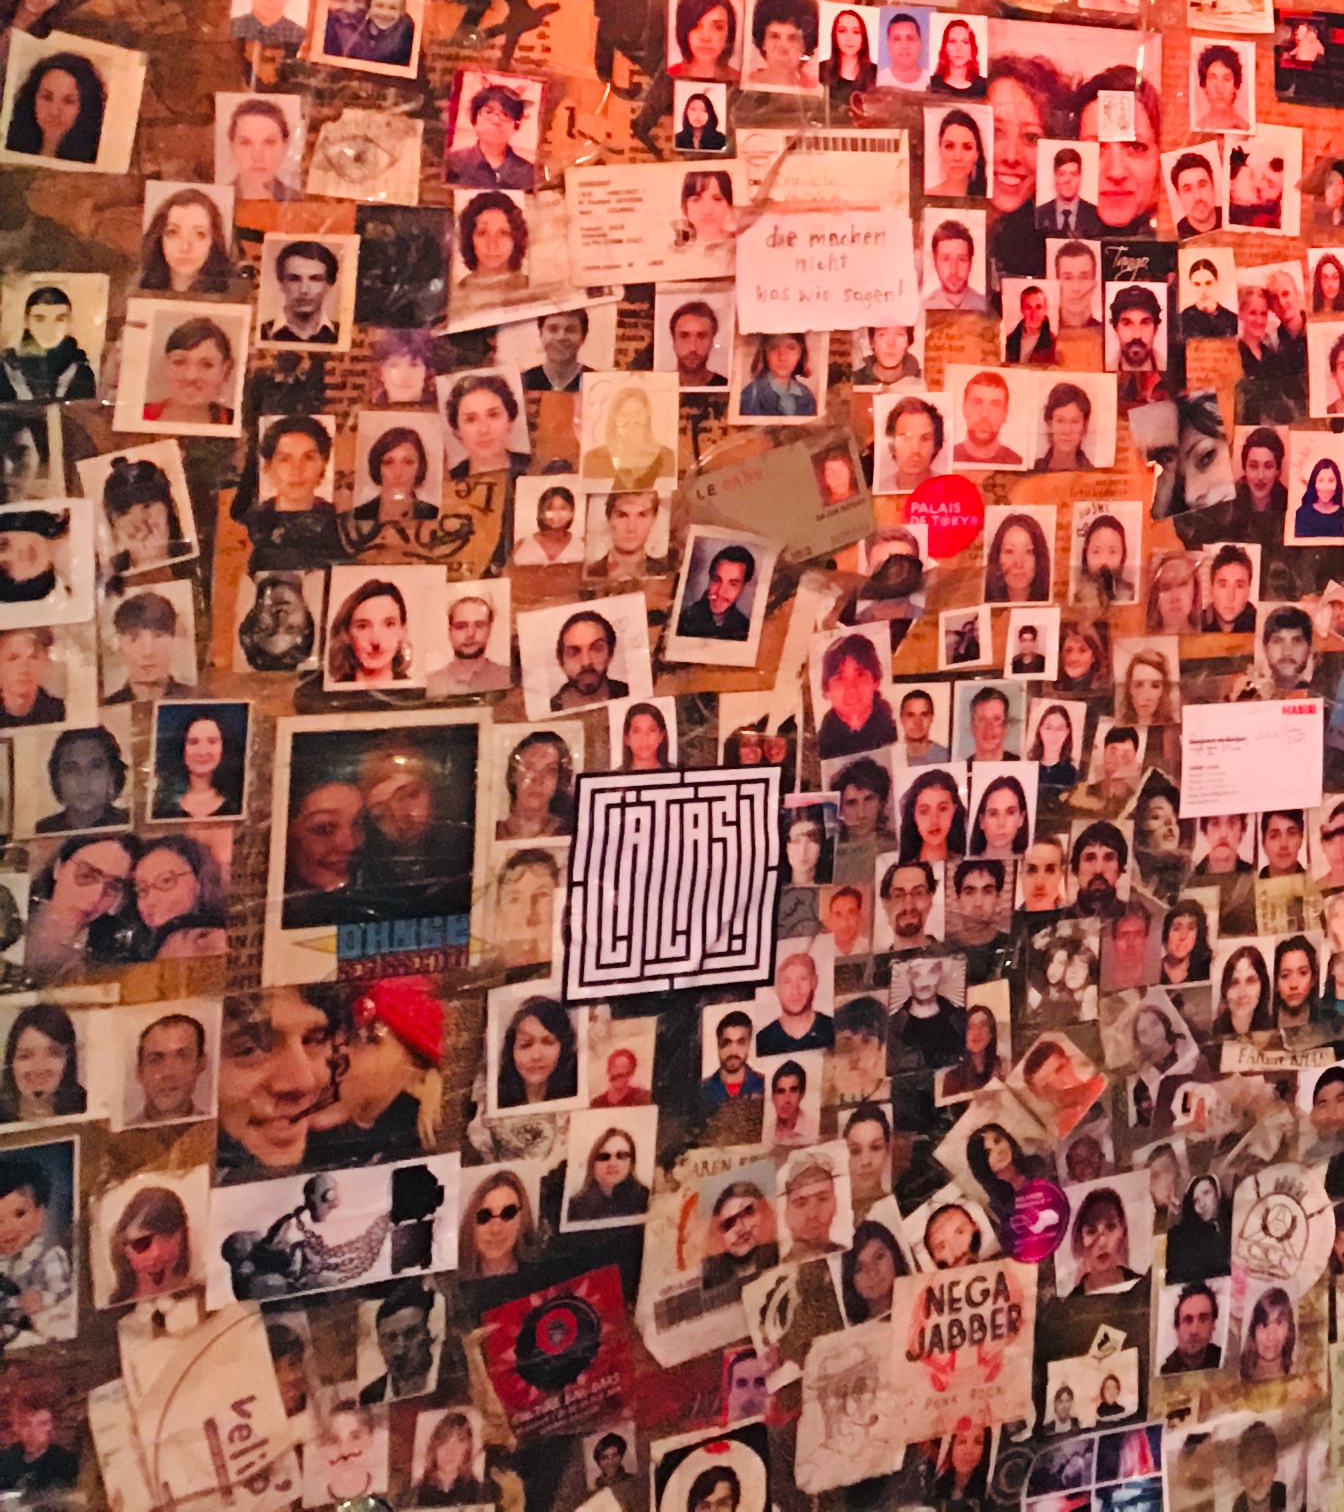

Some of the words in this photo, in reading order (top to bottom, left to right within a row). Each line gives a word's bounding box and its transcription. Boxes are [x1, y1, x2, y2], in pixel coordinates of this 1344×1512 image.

[909, 501, 962, 515] PALAIS
[930, 515, 979, 528] TOKYO
[923, 1270, 1011, 1320] NEGA
[904, 1302, 1023, 1363] JABBER
